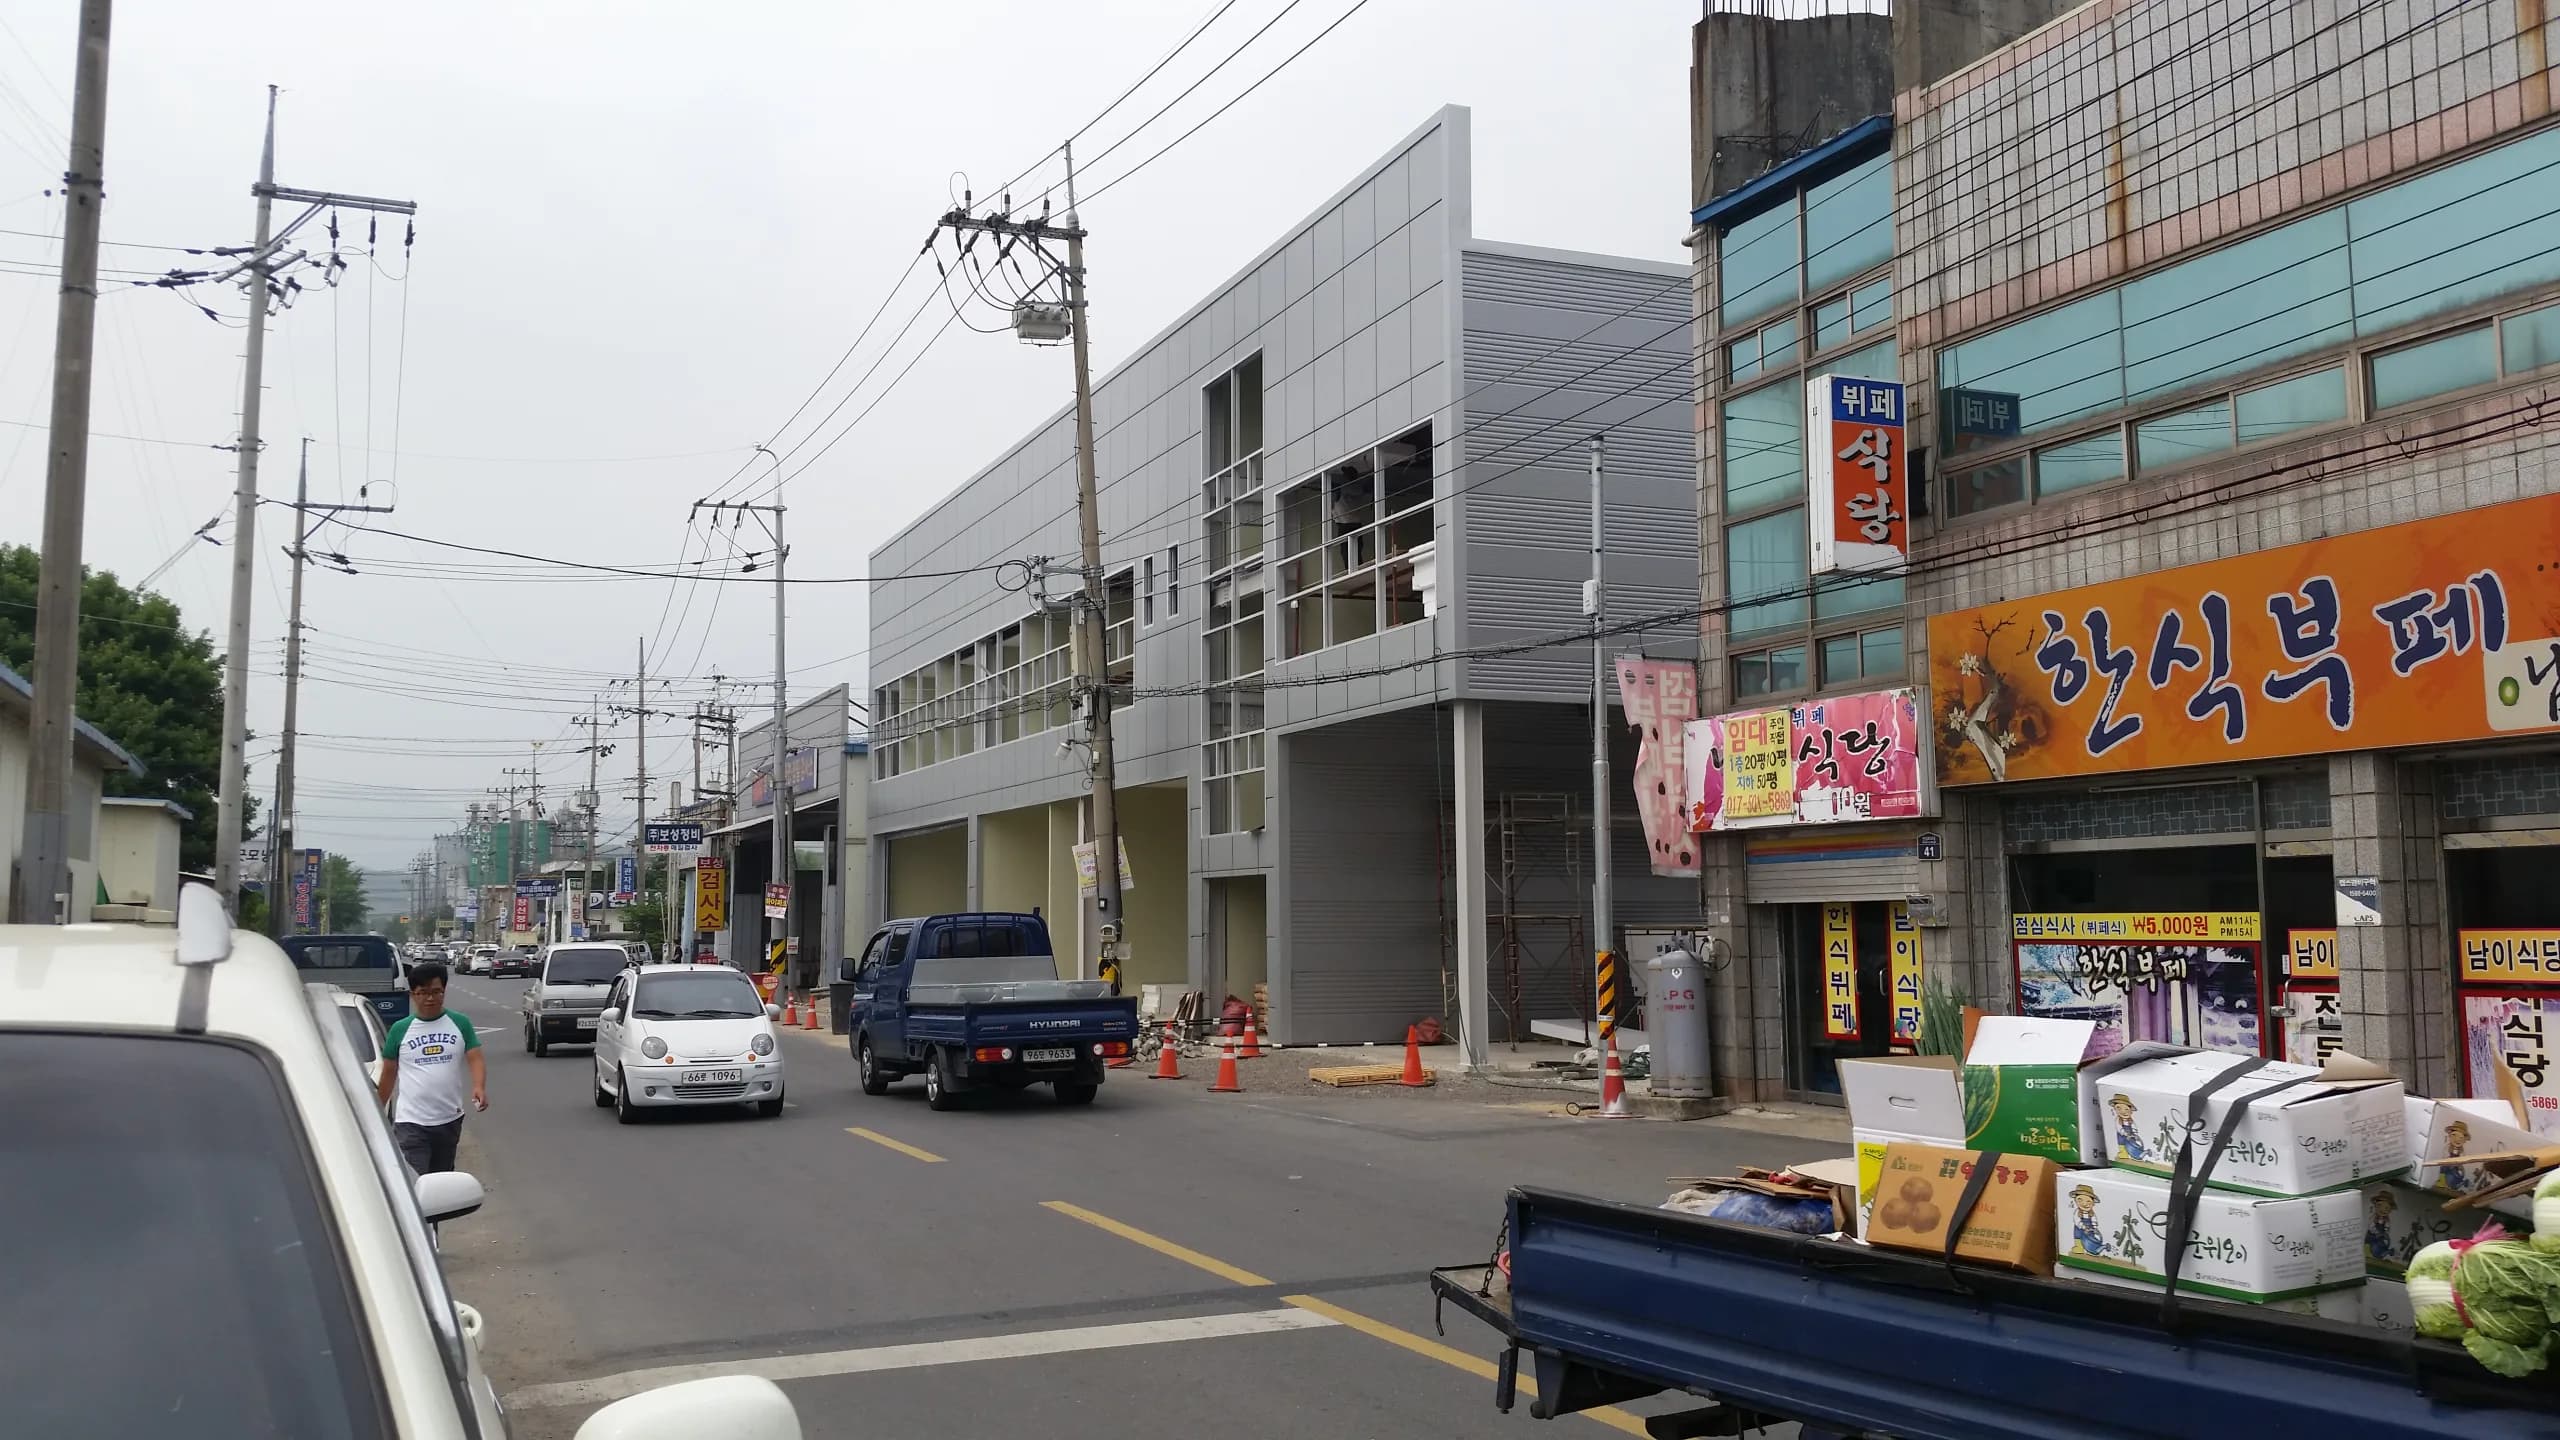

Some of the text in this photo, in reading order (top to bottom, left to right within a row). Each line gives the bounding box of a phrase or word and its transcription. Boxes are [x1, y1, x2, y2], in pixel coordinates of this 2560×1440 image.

[1841, 385, 1895, 420] 뷔페
[1837, 427, 1903, 542] 식당
[2035, 569, 2508, 757] 한식부페
[1769, 716, 1785, 730] 주인
[1728, 716, 1768, 754] 임대
[1769, 731, 1785, 745] 직접
[1729, 748, 1787, 773] 1층 20평 10평
[1799, 721, 1891, 781] 식당
[1736, 771, 1778, 791] 지하 50평
[1923, 846, 1935, 857] 41
[699, 858, 724, 868] 보성
[700, 871, 721, 928] 검사소
[2015, 916, 2076, 936] 점심식사
[2081, 920, 2127, 935] (뷔페식)
[2220, 927, 2253, 938] PM15시
[2295, 938, 2336, 969] 남이
[1827, 907, 1853, 1031] 한식뷔페
[1029, 1020, 1081, 1029] HYUNDAI
[408, 1033, 458, 1050] DICKIES
[1048, 1049, 1071, 1059] 9633
[711, 1069, 736, 1081] 1096
[2189, 1229, 2248, 1264] 군위오이
